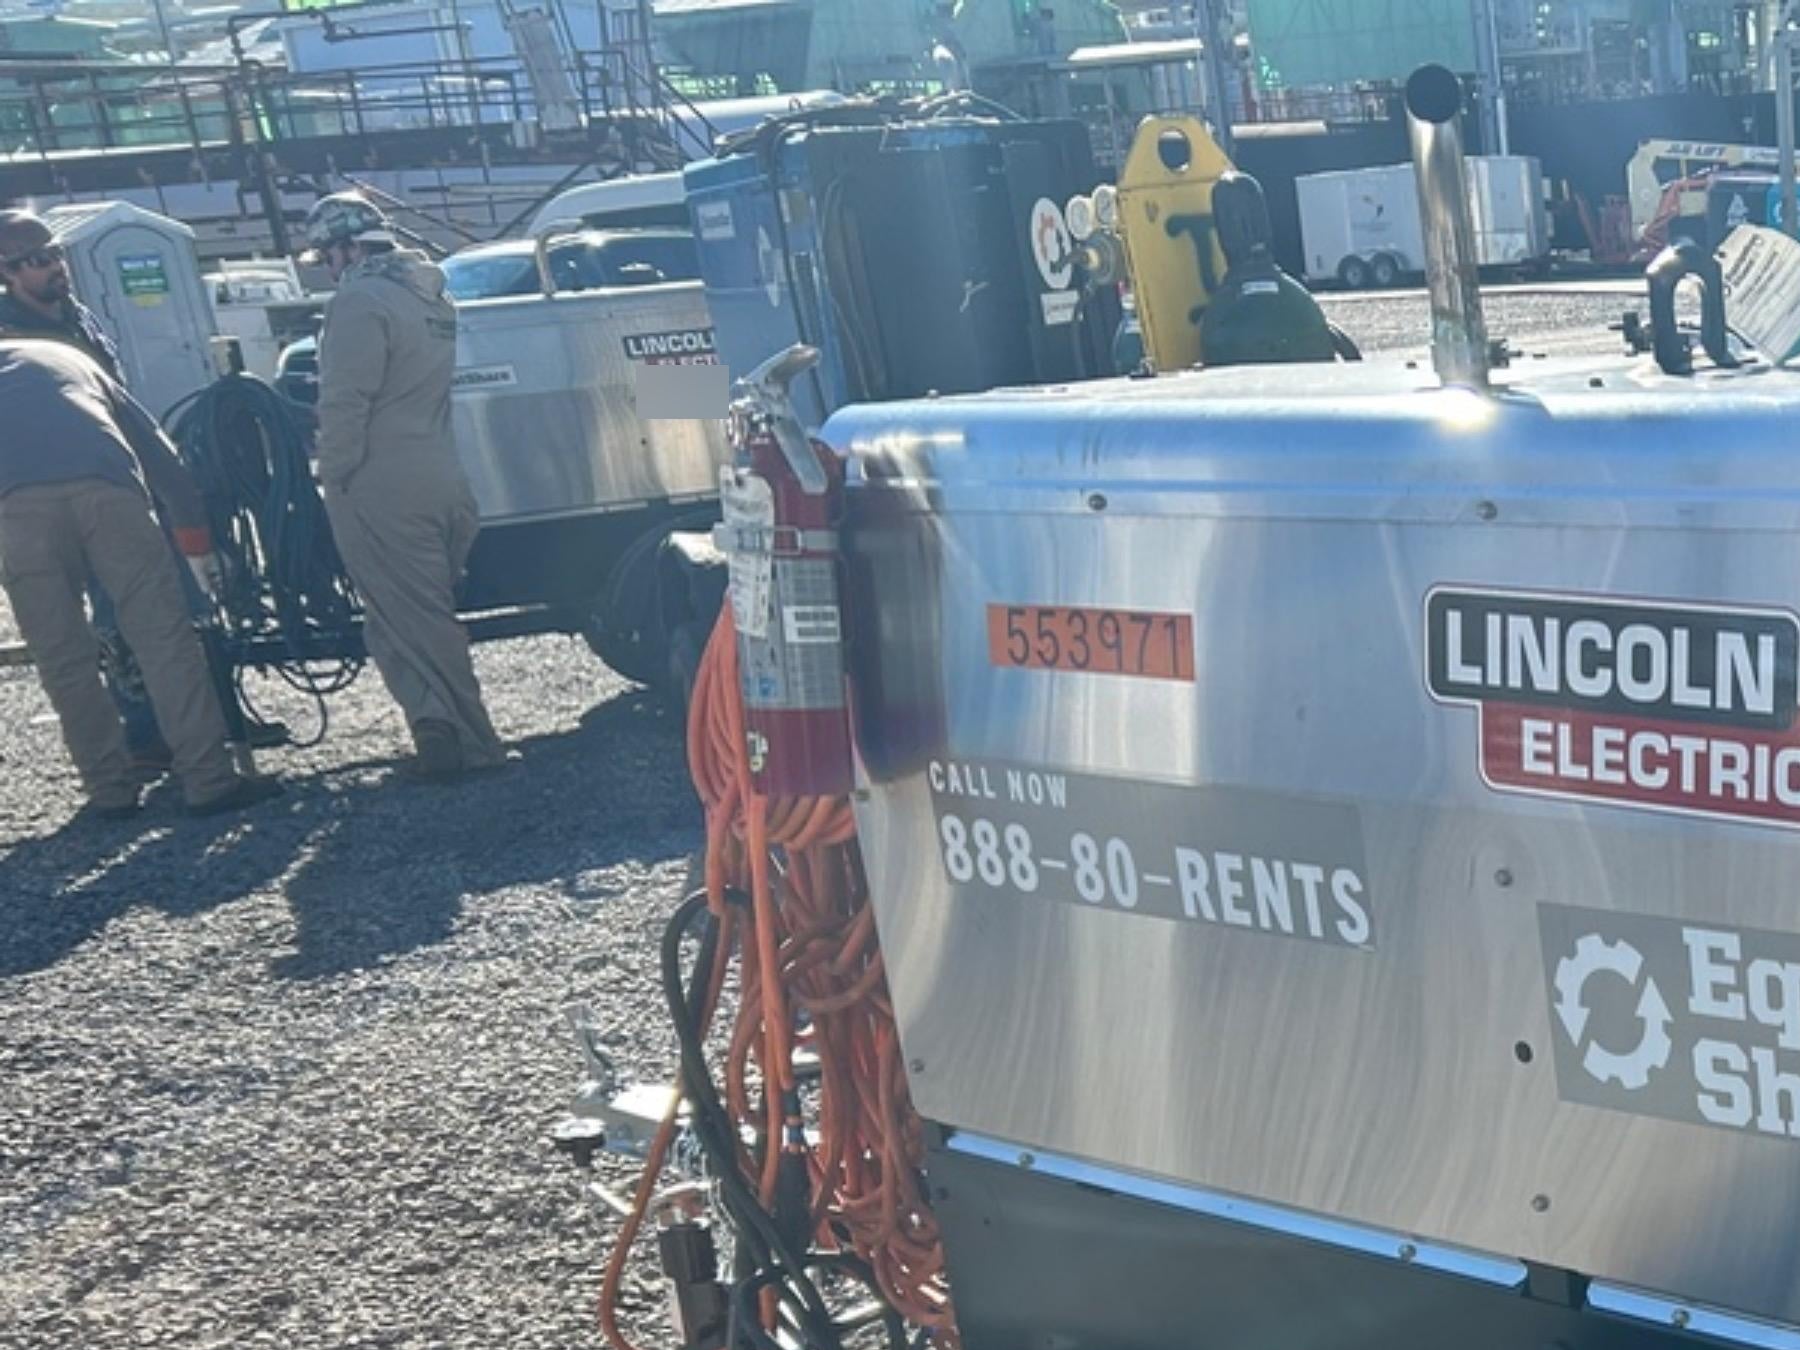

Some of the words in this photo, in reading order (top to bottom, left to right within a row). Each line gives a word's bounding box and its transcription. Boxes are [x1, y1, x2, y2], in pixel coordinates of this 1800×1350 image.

[1006, 607, 1181, 677] 553971
[1445, 608, 1775, 715] LINCOLN
[928, 760, 997, 800] CALL
[1008, 771, 1068, 808] NOW
[940, 814, 1371, 945] 888-80-RENTS
